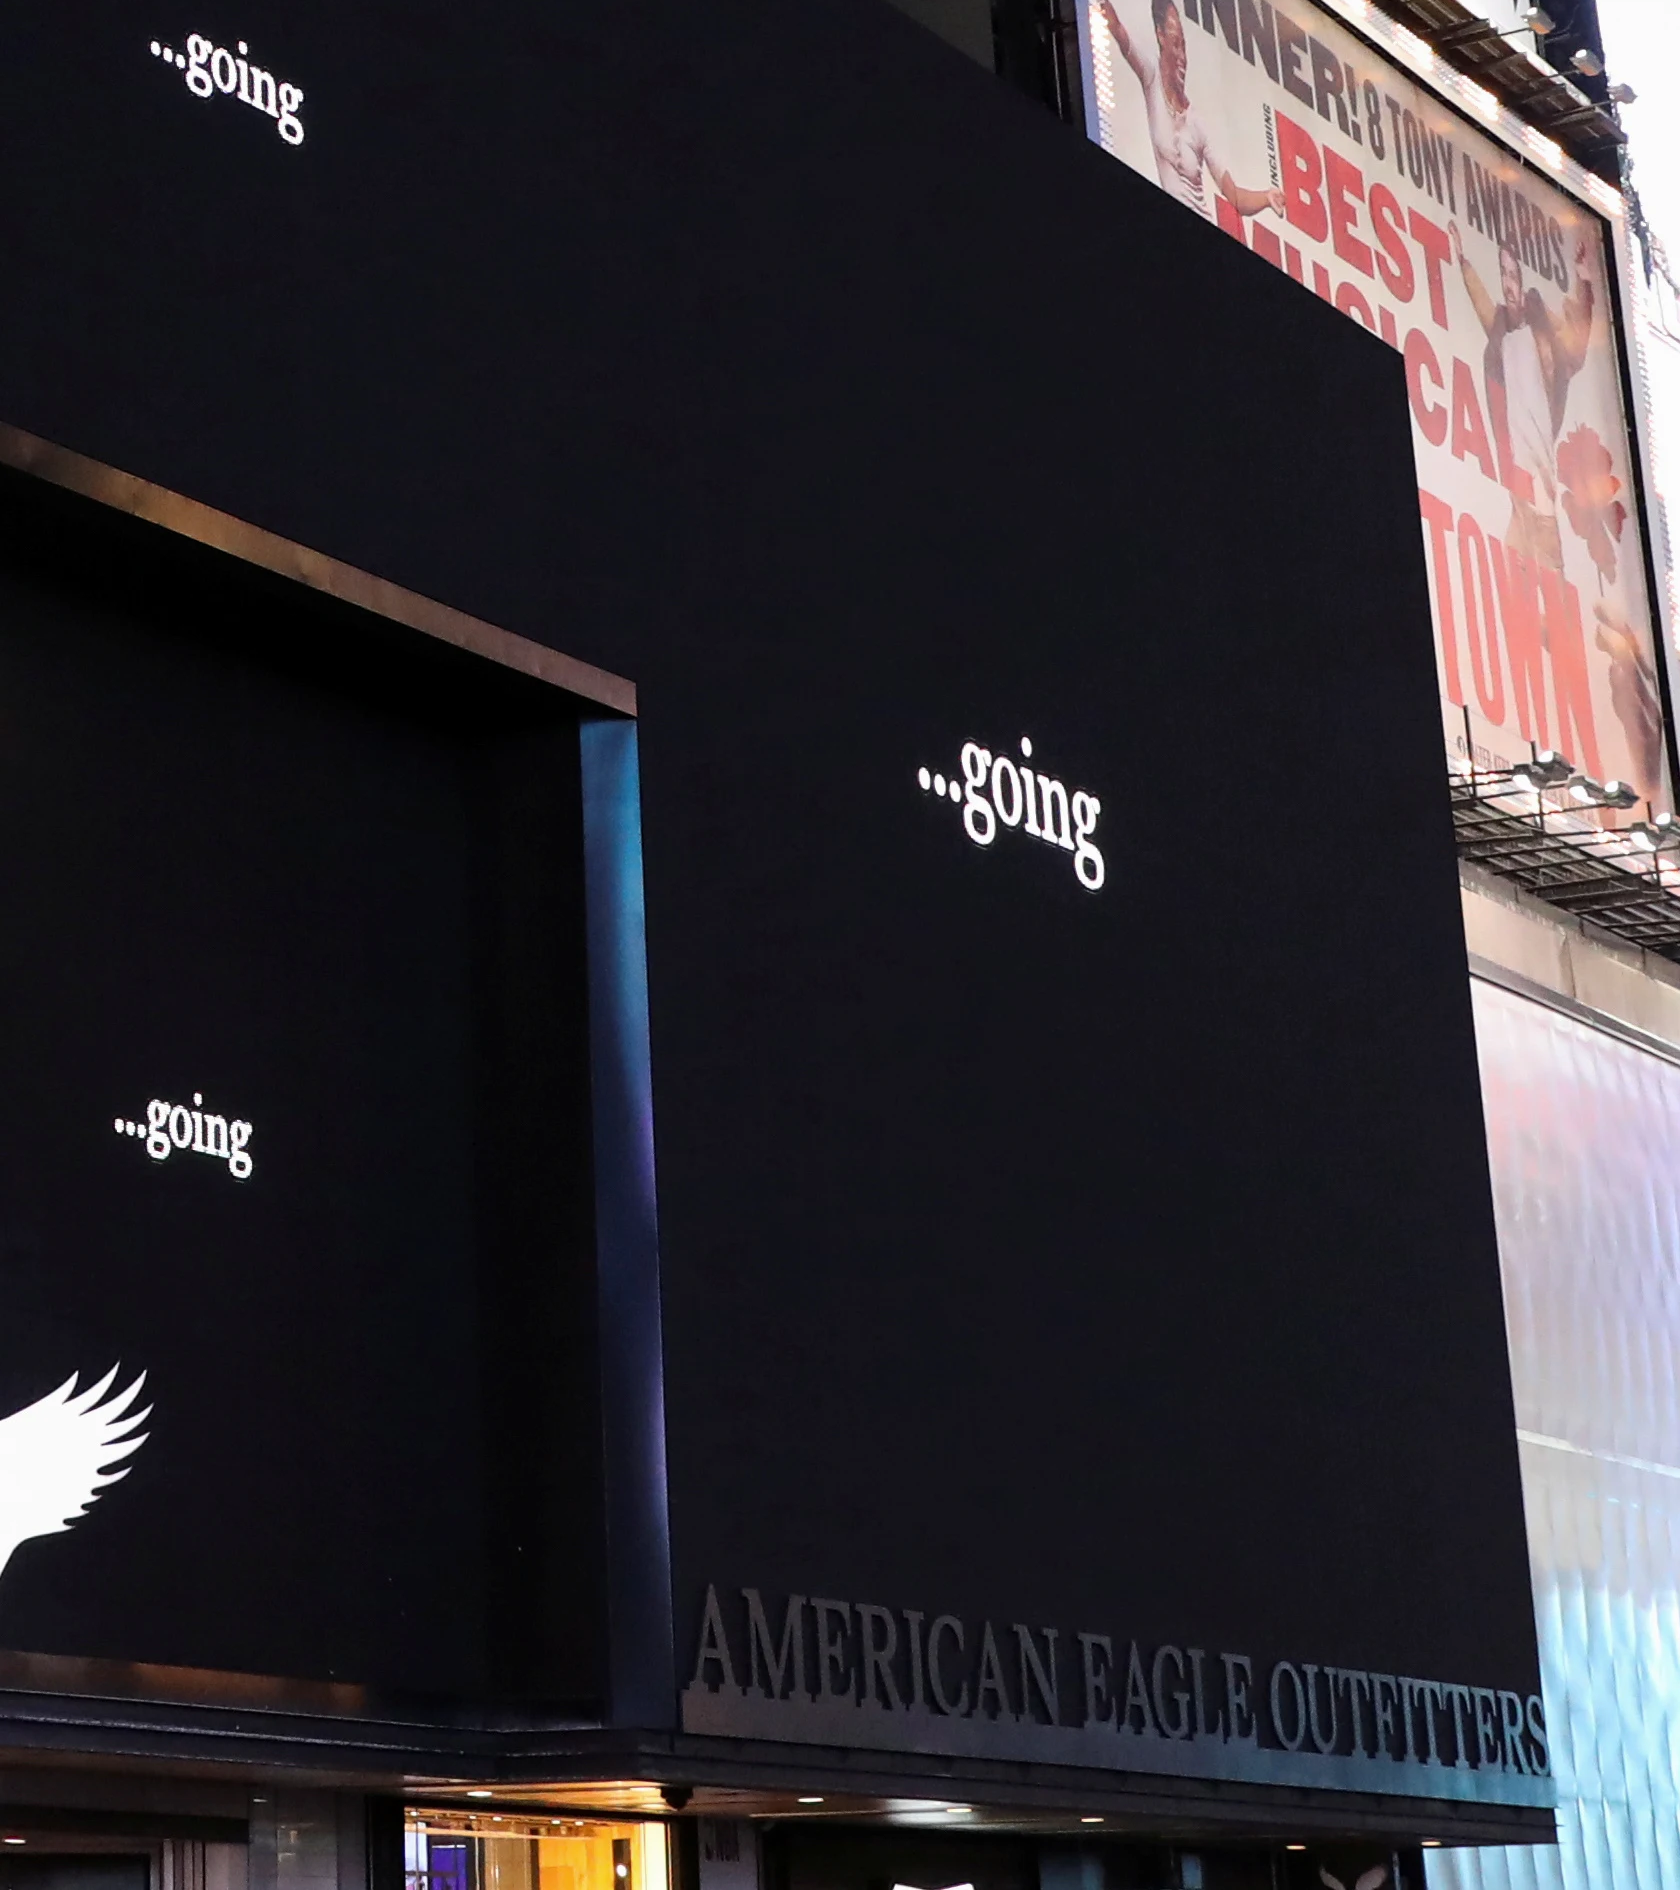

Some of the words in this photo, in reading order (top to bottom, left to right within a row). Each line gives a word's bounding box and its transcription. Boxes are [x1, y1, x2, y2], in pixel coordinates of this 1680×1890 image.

[150, 33, 305, 146] ...going
[1262, 103, 1281, 188] INCLUDING
[1275, 109, 1452, 331] BEST
[1363, 78, 1386, 164] 8
[1388, 94, 1457, 218] TONY
[1462, 152, 1570, 292] AWARDS
[918, 736, 1105, 891] ...going
[114, 1092, 253, 1179] ...going
[692, 1582, 1059, 1727] AMERICAN
[1078, 1632, 1259, 1751] EAGLE
[1270, 1659, 1552, 1778] OUTFITTERS
